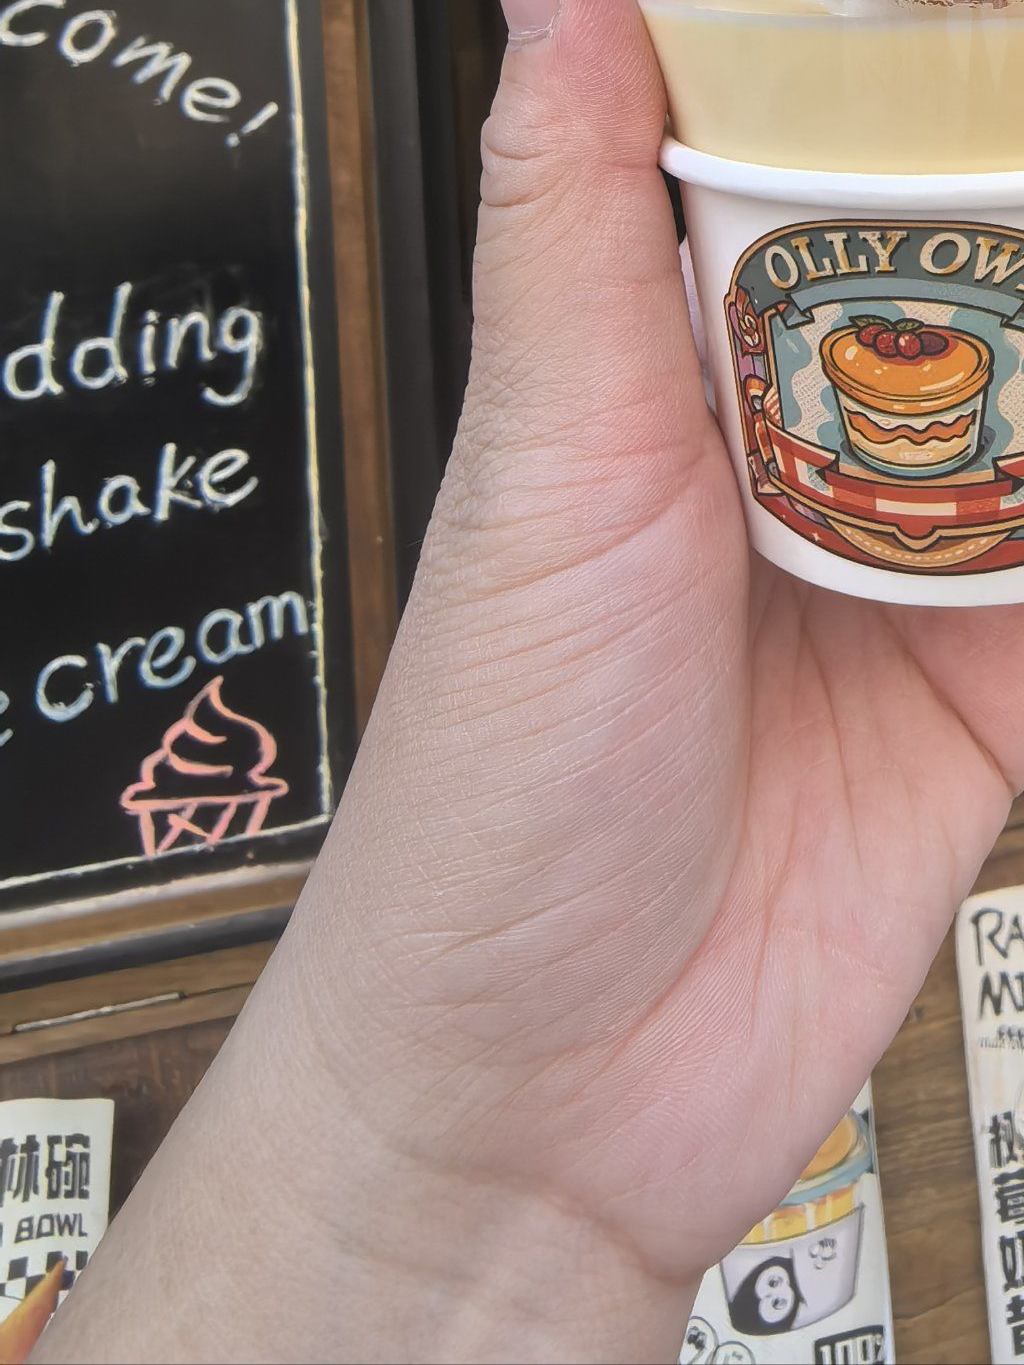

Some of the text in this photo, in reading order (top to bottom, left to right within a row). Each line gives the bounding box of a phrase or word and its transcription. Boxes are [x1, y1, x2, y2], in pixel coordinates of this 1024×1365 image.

[764, 230, 908, 290] OLLY
[0, 442, 259, 562] shake
[36, 590, 309, 723] cream
[14, 1213, 88, 1244] BOWL
